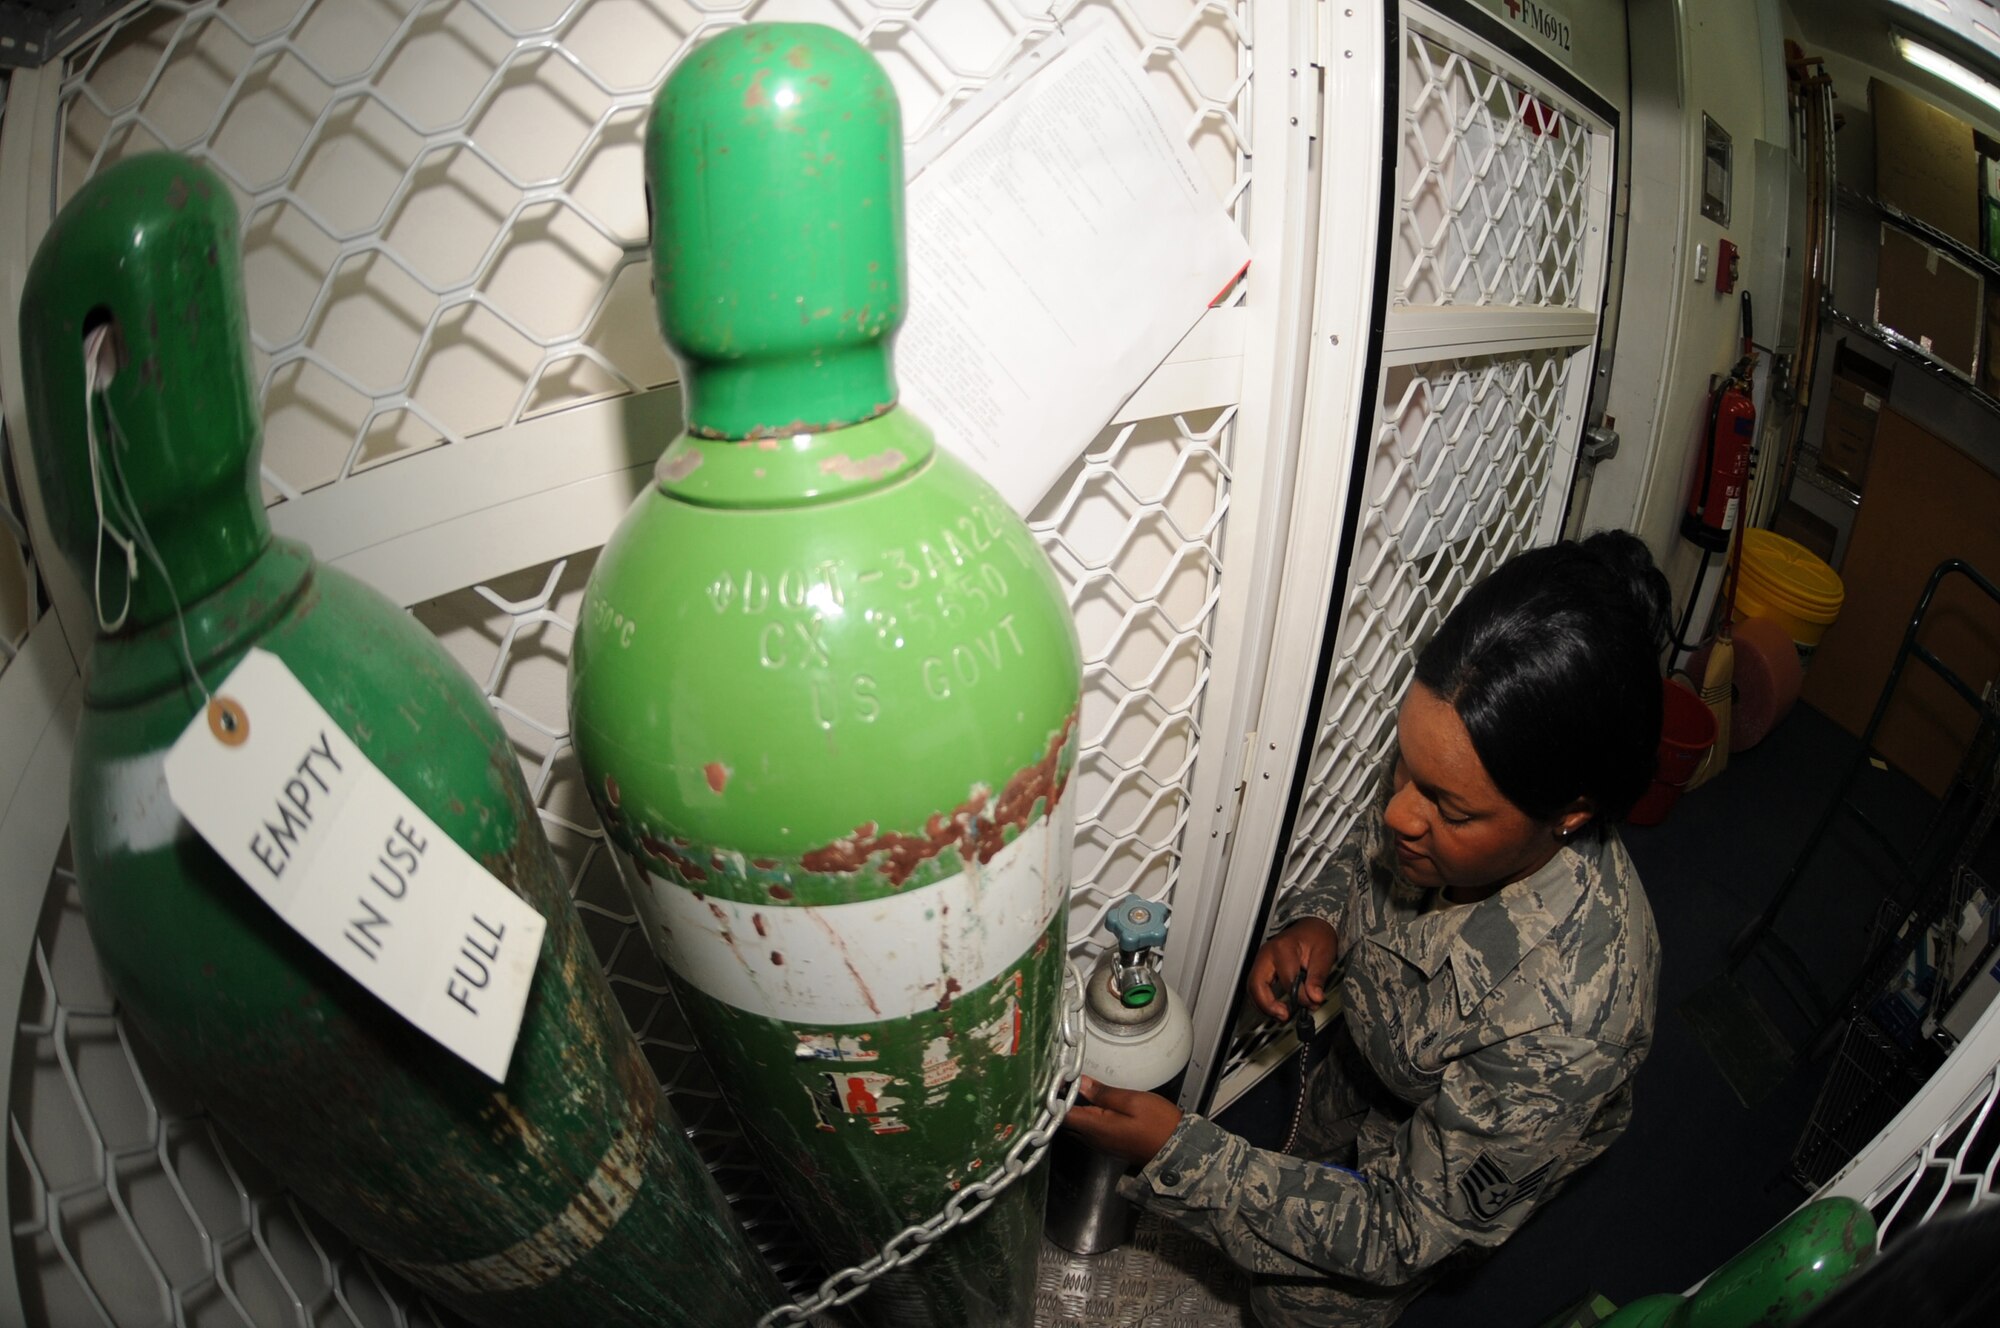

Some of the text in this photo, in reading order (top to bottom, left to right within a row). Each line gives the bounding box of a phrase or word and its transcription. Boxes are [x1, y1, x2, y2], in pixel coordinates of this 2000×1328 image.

[1521, 0, 1570, 51] FM6912
[922, 613, 1025, 702] GOVT
[249, 730, 343, 878] EMPTY
[343, 817, 428, 961] IN USE
[446, 913, 507, 1017] FULL
